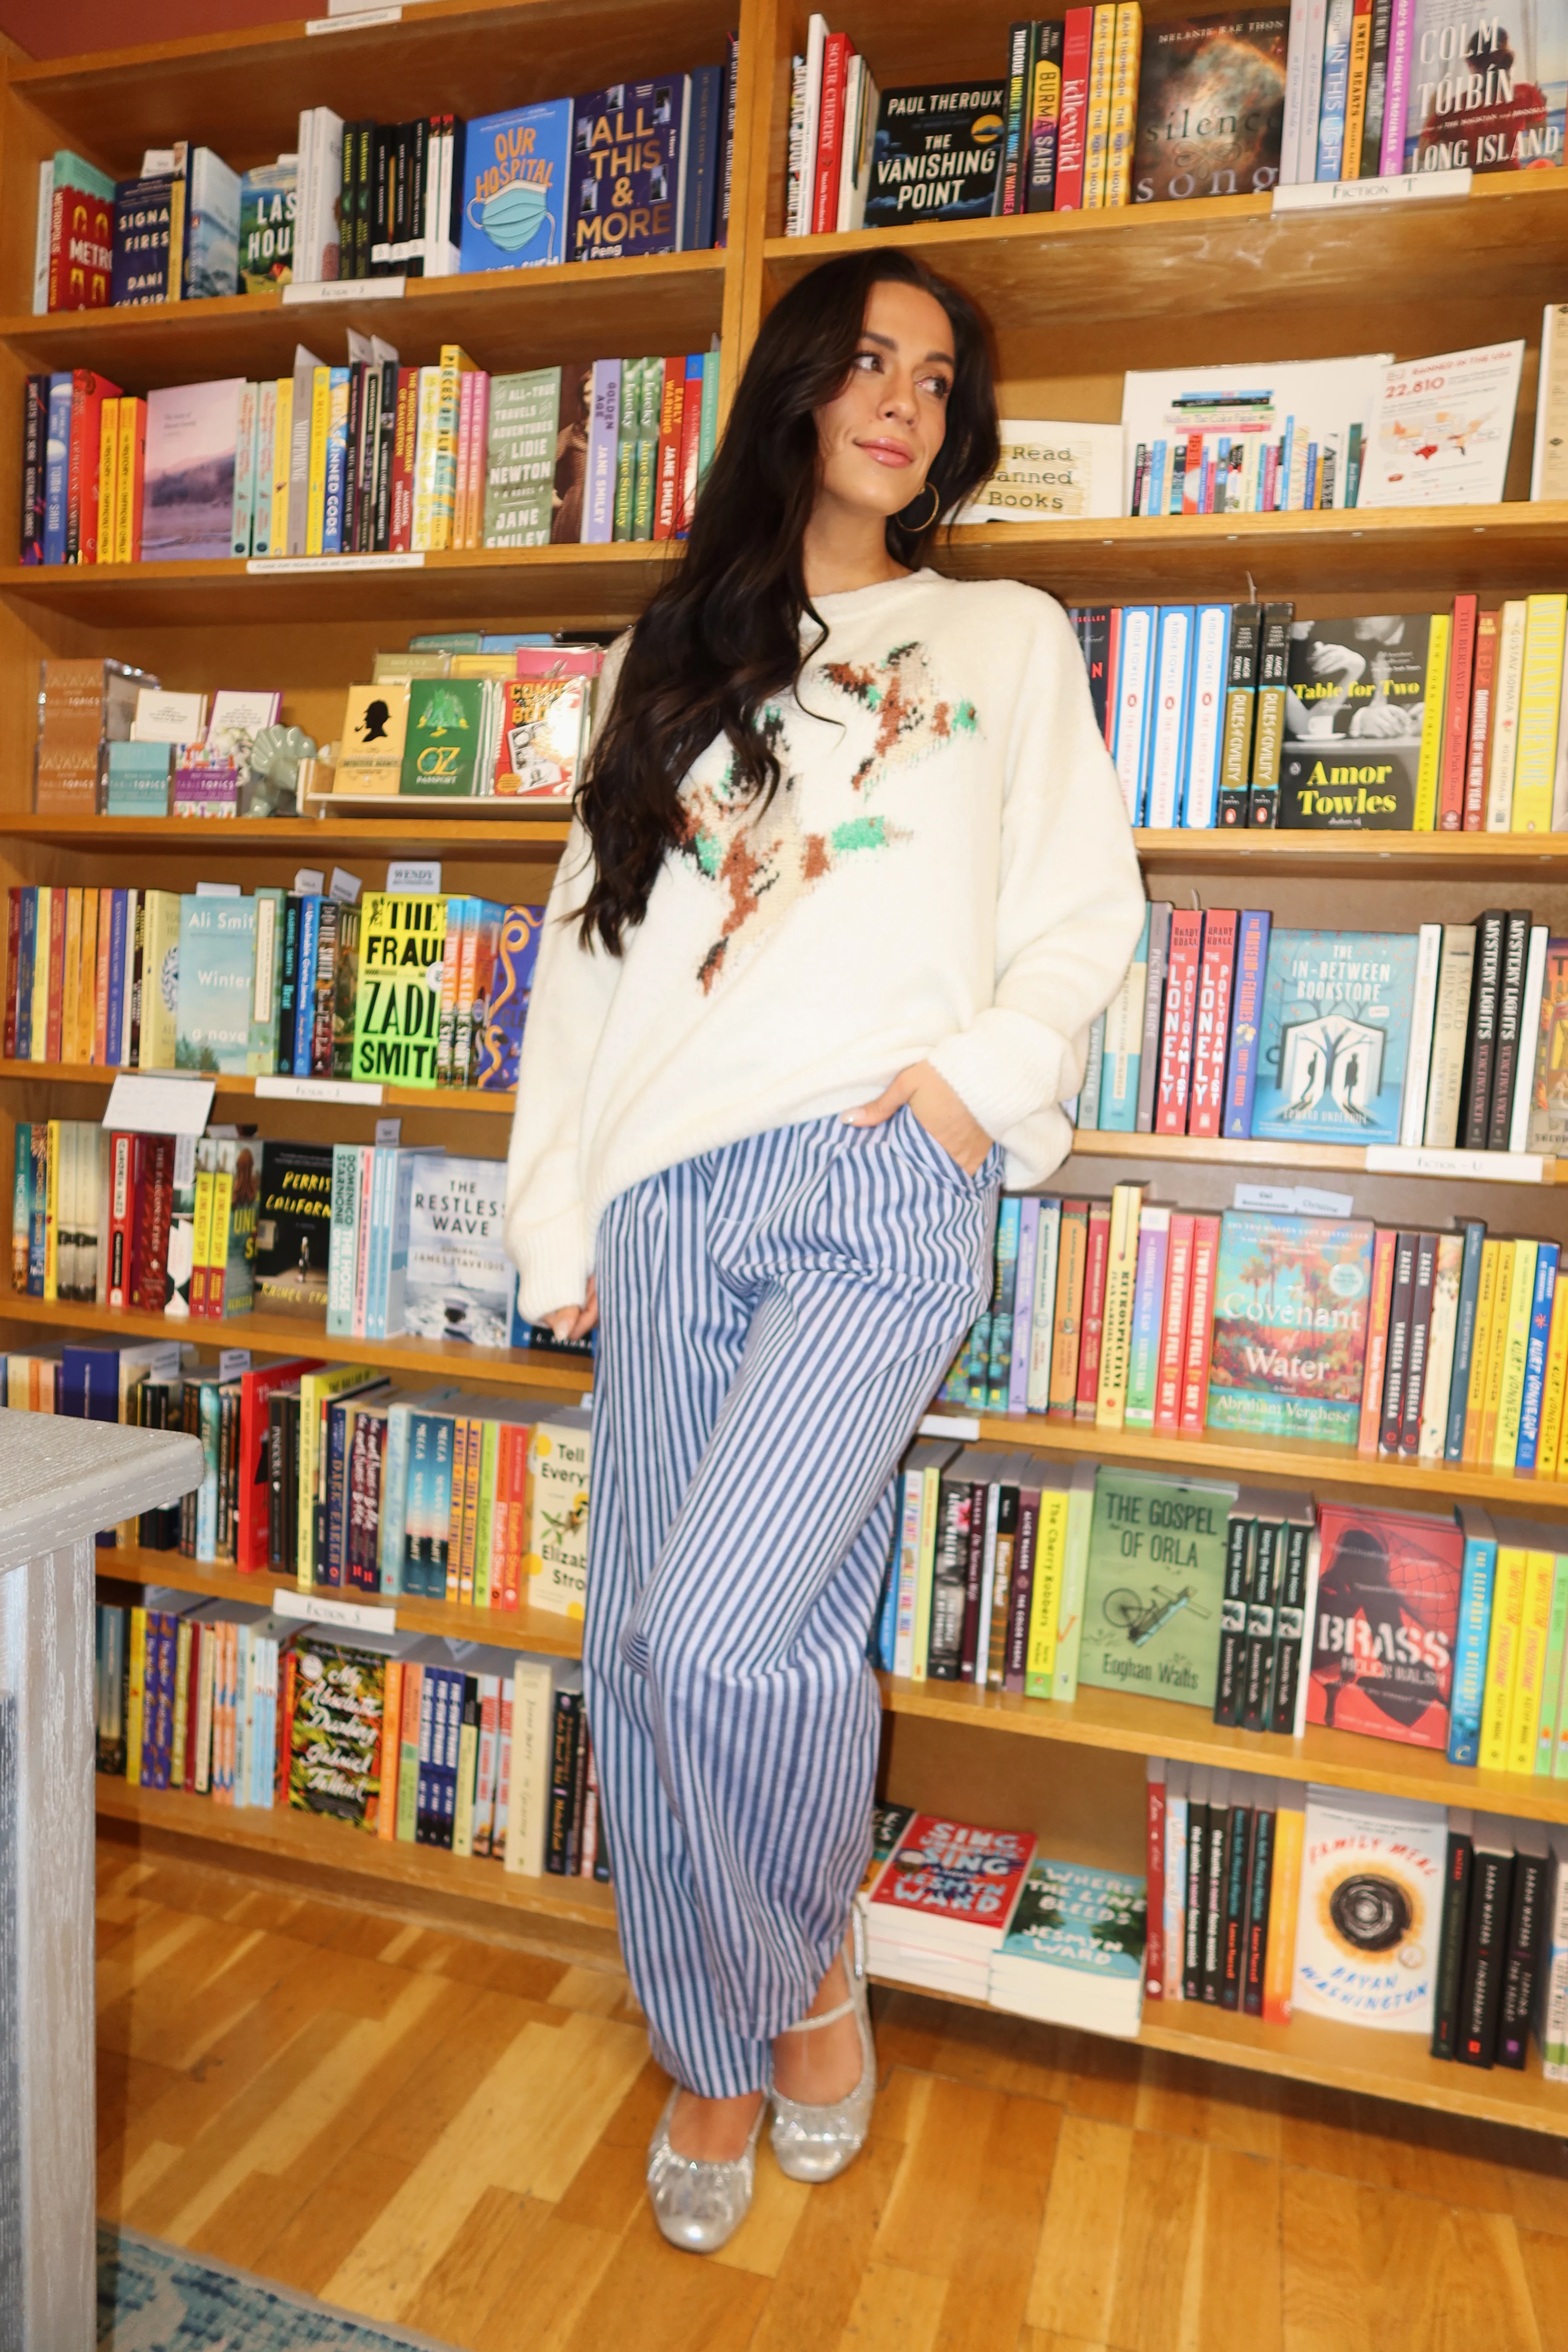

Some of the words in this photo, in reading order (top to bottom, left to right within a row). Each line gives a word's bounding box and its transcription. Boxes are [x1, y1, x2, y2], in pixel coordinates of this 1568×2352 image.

[1011, 29, 1026, 76] THEROUX
[1330, 44, 1347, 63] IN
[1355, 23, 1367, 61] SWEET
[1420, 15, 1500, 65] COLM
[826, 42, 841, 84] SOUR
[887, 95, 926, 118] PAUL
[929, 89, 1004, 113] THEROUX
[1010, 76, 1024, 110] UNDER
[1035, 70, 1057, 131] BURMA
[1325, 67, 1345, 110] THIS
[1351, 71, 1364, 116] HEARTS
[1417, 63, 1515, 119] TÓIBÍN
[591, 107, 655, 147] ALL
[820, 87, 836, 151] CHERRY
[1008, 112, 1021, 131] THE
[1058, 79, 1085, 173] idlewild
[495, 127, 536, 162] OUR
[925, 133, 953, 151] THE
[1005, 132, 1020, 159] WAVE
[1320, 116, 1343, 170] LIGHT
[1411, 139, 1469, 173] LONG
[1475, 126, 1559, 166] ISLAND
[589, 140, 661, 180] THIS
[877, 148, 997, 186] VANISHING
[1005, 162, 1017, 175] AT
[1032, 135, 1054, 187] SAHIB
[475, 158, 553, 203] HOSPITAL
[611, 177, 633, 208] &
[897, 179, 966, 212] POINT
[1002, 175, 1016, 215] WAIMEA
[1135, 166, 1279, 204] song
[1333, 181, 1389, 199] FICTION
[1403, 177, 1418, 193] T
[51, 191, 64, 254] METROPOLIS
[576, 204, 672, 247] MORE
[125, 230, 170, 253] FIRES
[591, 243, 622, 258] Peng
[127, 271, 163, 291] DANI
[400, 387, 407, 400] OF
[409, 371, 418, 388] THE
[508, 383, 556, 402] ALL-TRUE
[407, 389, 416, 431] MEDICINE
[494, 404, 537, 421] TRAVELS
[595, 394, 605, 418] AGE
[605, 381, 616, 430] GOLDEN
[621, 382, 636, 428] Lucky
[662, 379, 675, 435] WARNING
[673, 387, 684, 425] EARLY
[395, 401, 407, 458] GALVESTON
[492, 420, 554, 439] ADVENTURES
[404, 431, 415, 473] WOMAN
[511, 438, 548, 460] LIDIE
[596, 444, 609, 477] JANE
[620, 441, 632, 477] Jane
[1011, 446, 1073, 461] Read
[490, 460, 551, 485] NEWTON
[989, 470, 1073, 485] anned
[593, 478, 608, 525] SMILEY
[616, 477, 630, 528] Smiley
[988, 491, 1064, 509] Books
[496, 508, 539, 530] JANE
[486, 530, 546, 548] SMILEY
[1293, 682, 1343, 701] Table
[1347, 681, 1375, 699] for
[1381, 679, 1420, 697] Two
[416, 747, 461, 775] OZ
[1307, 761, 1393, 787] Amor
[1296, 787, 1397, 818] Towles
[394, 869, 434, 879] WENDY
[189, 912, 211, 928] Ali
[1333, 944, 1352, 959] THE
[1482, 919, 1501, 986] MYSTERY
[1291, 961, 1391, 983] IN-BETWEEN
[1296, 982, 1382, 1002] BOOKSTORE
[1441, 964, 1457, 1032] HUNGER
[1455, 966, 1472, 1029] SACRED
[1477, 986, 1496, 1041] LIGHTS
[1161, 964, 1181, 1106] LONELY
[1176, 965, 1195, 1106] POLYGAMIST
[335, 1154, 345, 1225] STARNONE
[345, 1154, 356, 1227] DOMENICO
[450, 1180, 477, 1194] THE
[343, 1228, 354, 1253] THE
[432, 1217, 490, 1237] WAVE
[1172, 1249, 1187, 1273] TWO
[1399, 1250, 1412, 1284] ZAZEN
[340, 1255, 354, 1312] HOUSE
[1167, 1275, 1185, 1333] FEATHERS
[1223, 1292, 1362, 1333] Covenant
[1164, 1336, 1179, 1365] FELL
[1392, 1321, 1406, 1370] VANESSA
[1243, 1345, 1332, 1382] Water
[1161, 1381, 1176, 1408] SKY
[1216, 1395, 1281, 1416] Abraham
[1285, 1401, 1351, 1424] Verghese
[1387, 1373, 1400, 1420] VESELKA
[557, 1443, 585, 1463] Tell
[541, 1462, 591, 1489] Every
[1021, 1510, 1032, 1535] ALICE
[1050, 1502, 1061, 1528] The
[1106, 1492, 1140, 1524] THE
[1148, 1500, 1218, 1537] GOSPEL
[1018, 1536, 1030, 1571] WALKER
[1045, 1530, 1060, 1572] Cherry
[1121, 1531, 1146, 1557] OF
[1149, 1534, 1198, 1568] ORLA
[1039, 1574, 1054, 1629] Robbers
[1317, 1613, 1452, 1669] BRASS
[1102, 1651, 1152, 1682] Eoghan
[1158, 1660, 1199, 1690] Watts
[922, 1847, 1010, 1876] SING
[1308, 1836, 1380, 1865] FAMILY
[1388, 1842, 1439, 1878] MEAL
[893, 1882, 1002, 1914] WARD
[1028, 1879, 1072, 1901] THE
[1079, 1887, 1148, 1913] LINE
[1044, 1868, 1135, 1896] WHERE
[1038, 1895, 1131, 1926] BLEEDS
[1022, 1925, 1123, 1953] JESMYN
[1033, 1938, 1112, 1966] WARD
[1299, 1963, 1428, 2010] WASHINGTON
[1331, 1965, 1399, 1990] BRYAN
